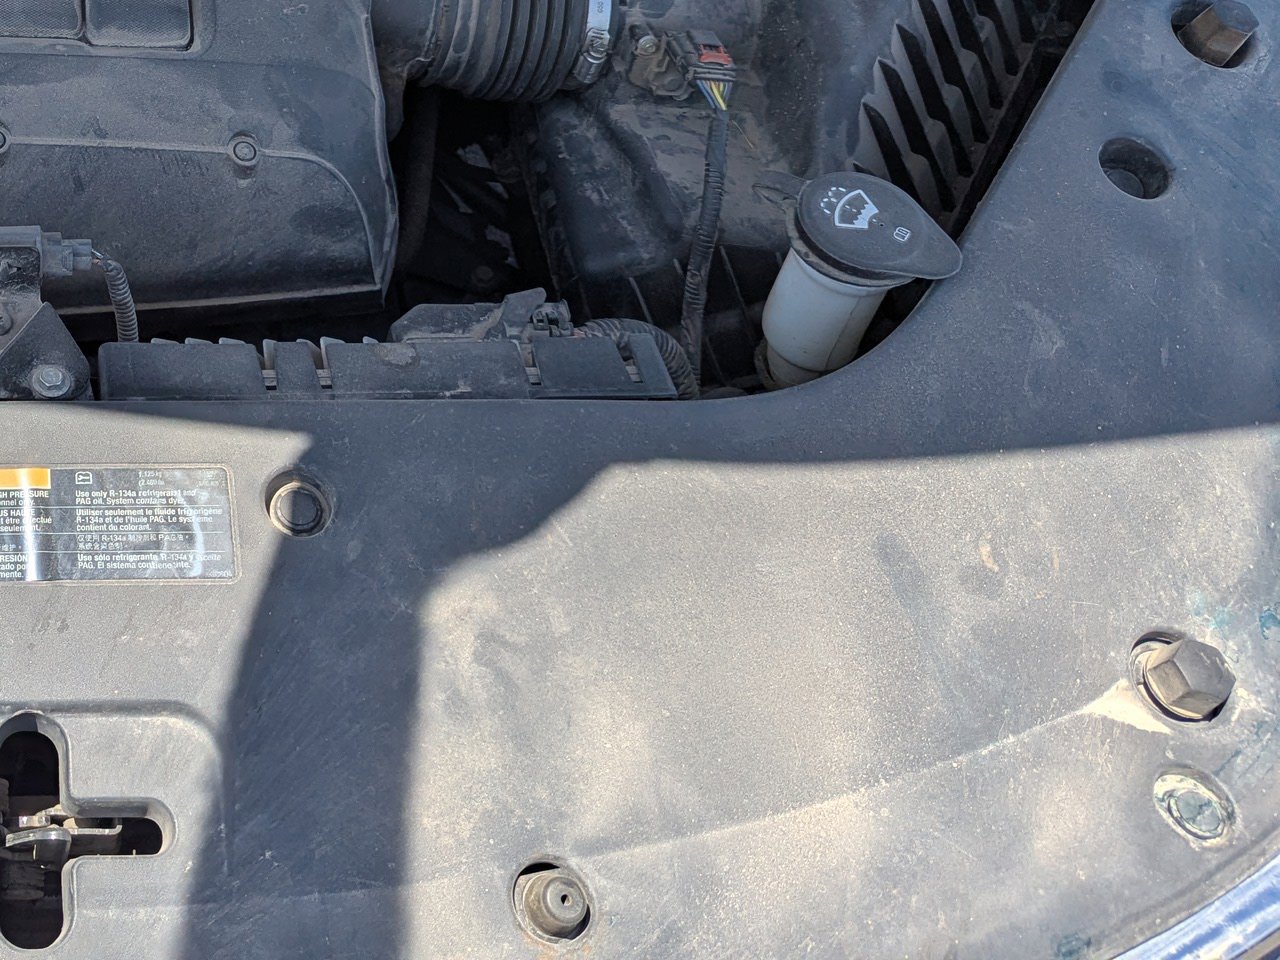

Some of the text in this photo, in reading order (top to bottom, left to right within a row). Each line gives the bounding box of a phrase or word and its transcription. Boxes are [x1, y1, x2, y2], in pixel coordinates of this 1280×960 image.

[92, 491, 107, 499] only
[107, 498, 134, 506] System
[146, 508, 153, 516] le
[154, 508, 176, 516] fluide
[5, 517, 20, 525] être
[76, 516, 103, 524] R-134a
[108, 524, 118, 532] du
[120, 524, 152, 532] colorant.
[78, 554, 93, 562] Use
[94, 553, 111, 561] sólo
[112, 553, 158, 562] refrigerante
